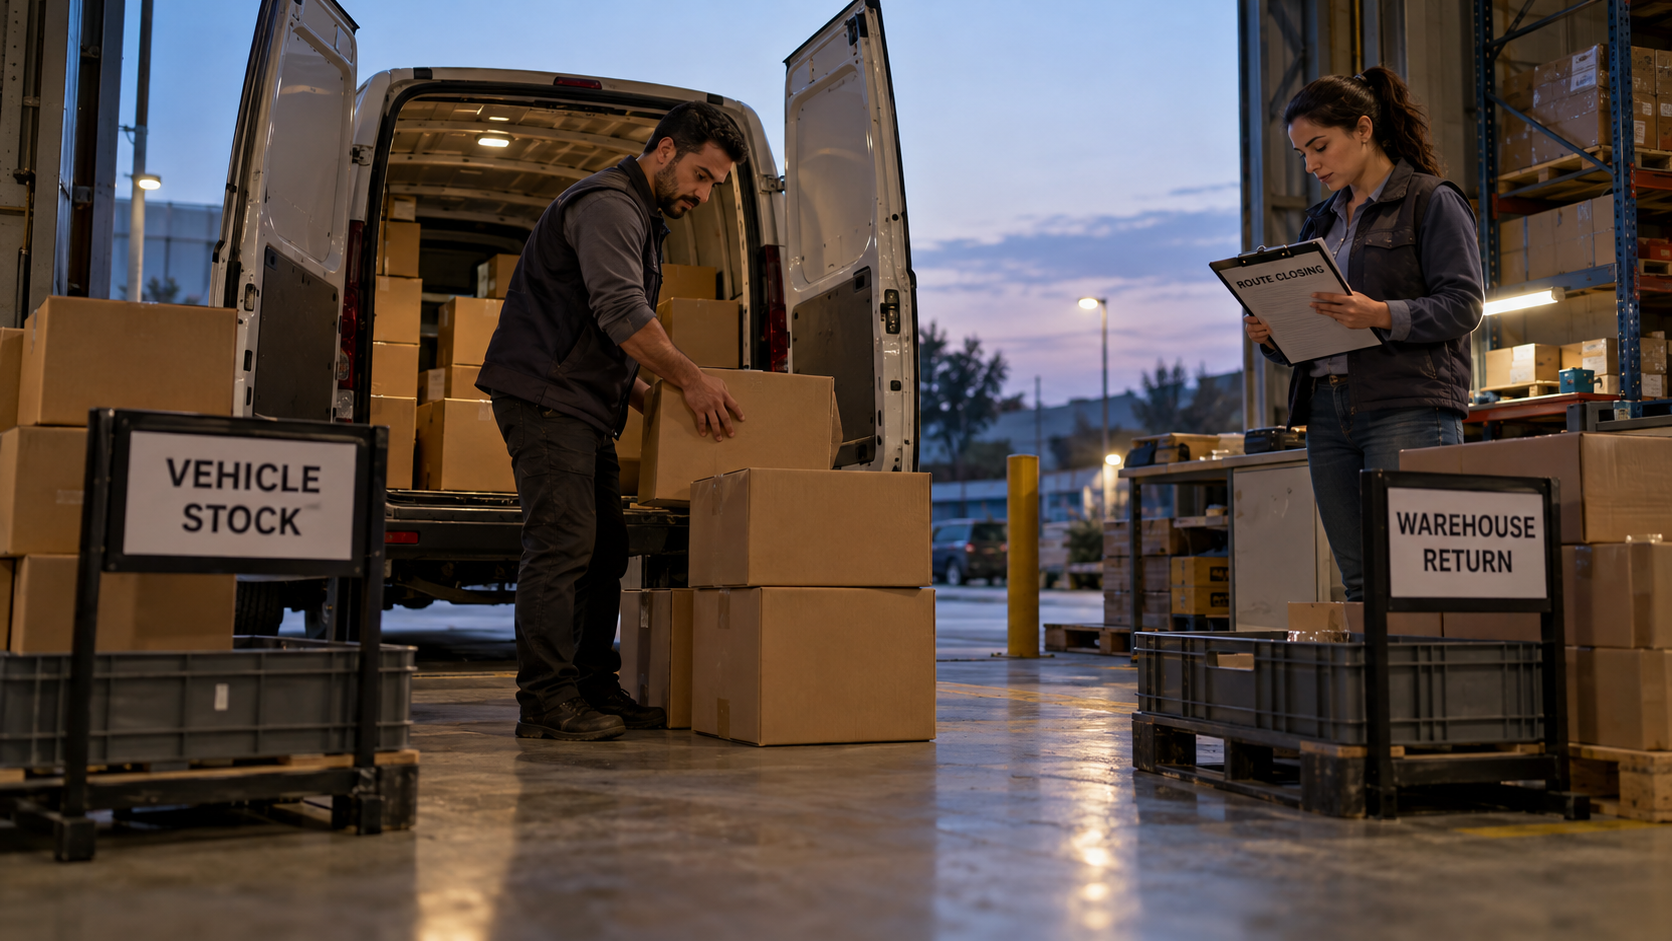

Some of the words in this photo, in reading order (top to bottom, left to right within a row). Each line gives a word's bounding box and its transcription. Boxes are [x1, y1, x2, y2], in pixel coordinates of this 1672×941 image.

[1236, 275, 1274, 289] ROUTE
[1276, 265, 1325, 281] CLOSING
[166, 457, 321, 493] VEHICLE
[182, 503, 302, 536] STOCK
[1397, 512, 1536, 539] WAREHOUSE
[1423, 548, 1512, 573] RETURN
